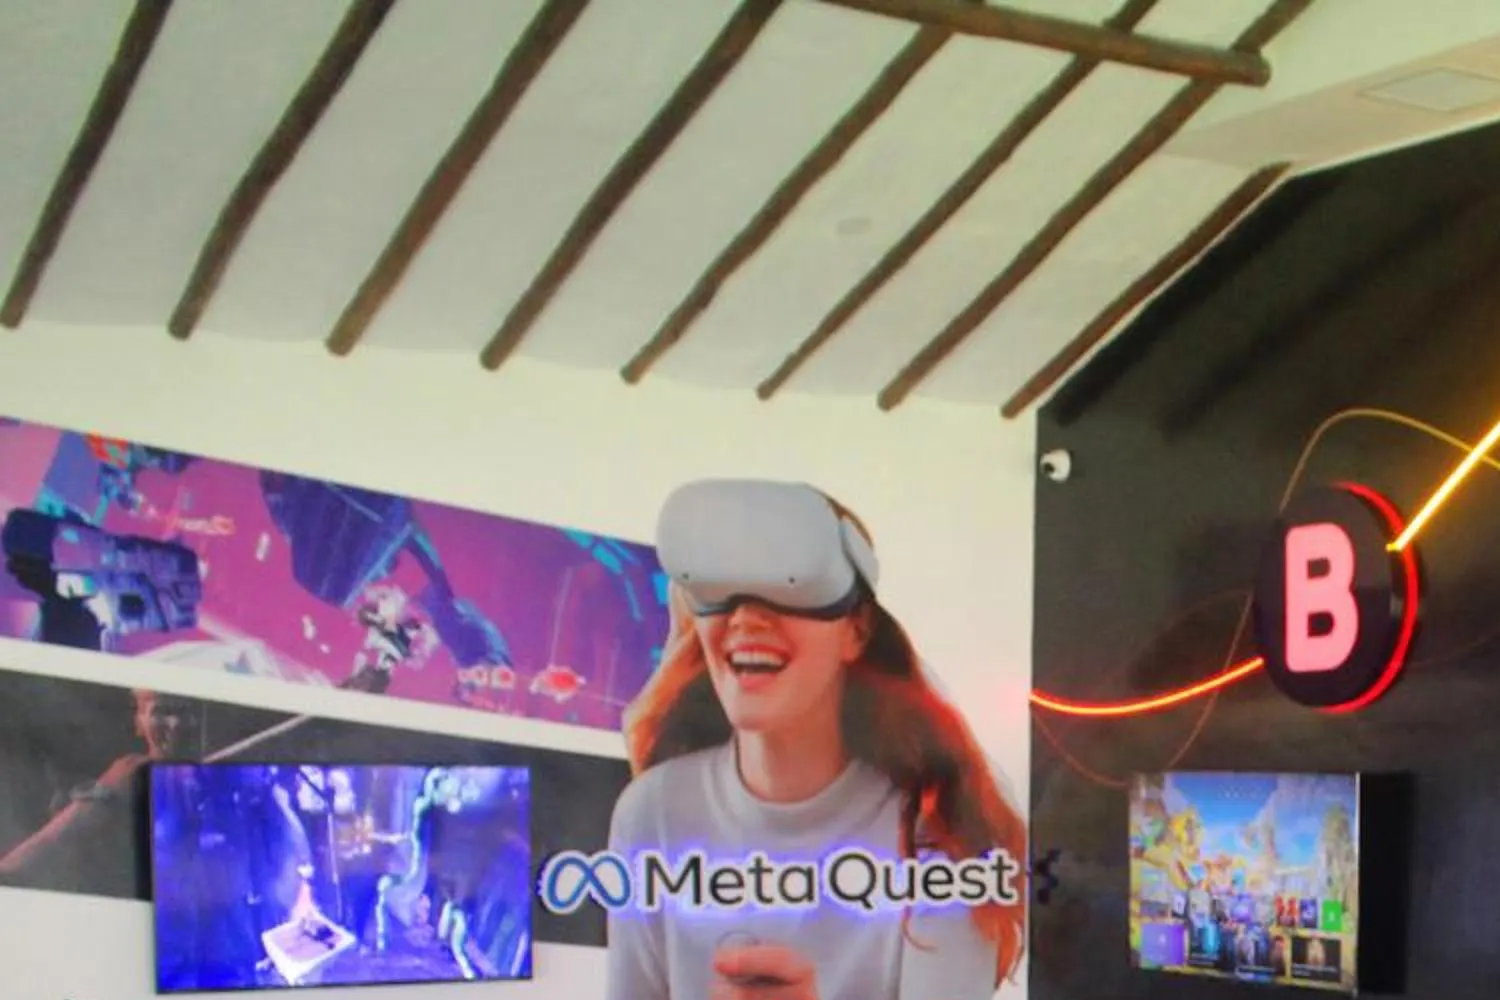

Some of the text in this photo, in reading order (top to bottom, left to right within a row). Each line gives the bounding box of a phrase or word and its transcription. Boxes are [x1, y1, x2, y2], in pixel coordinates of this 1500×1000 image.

[1285, 522, 1359, 673] B
[645, 852, 1015, 909] Meta Quest
